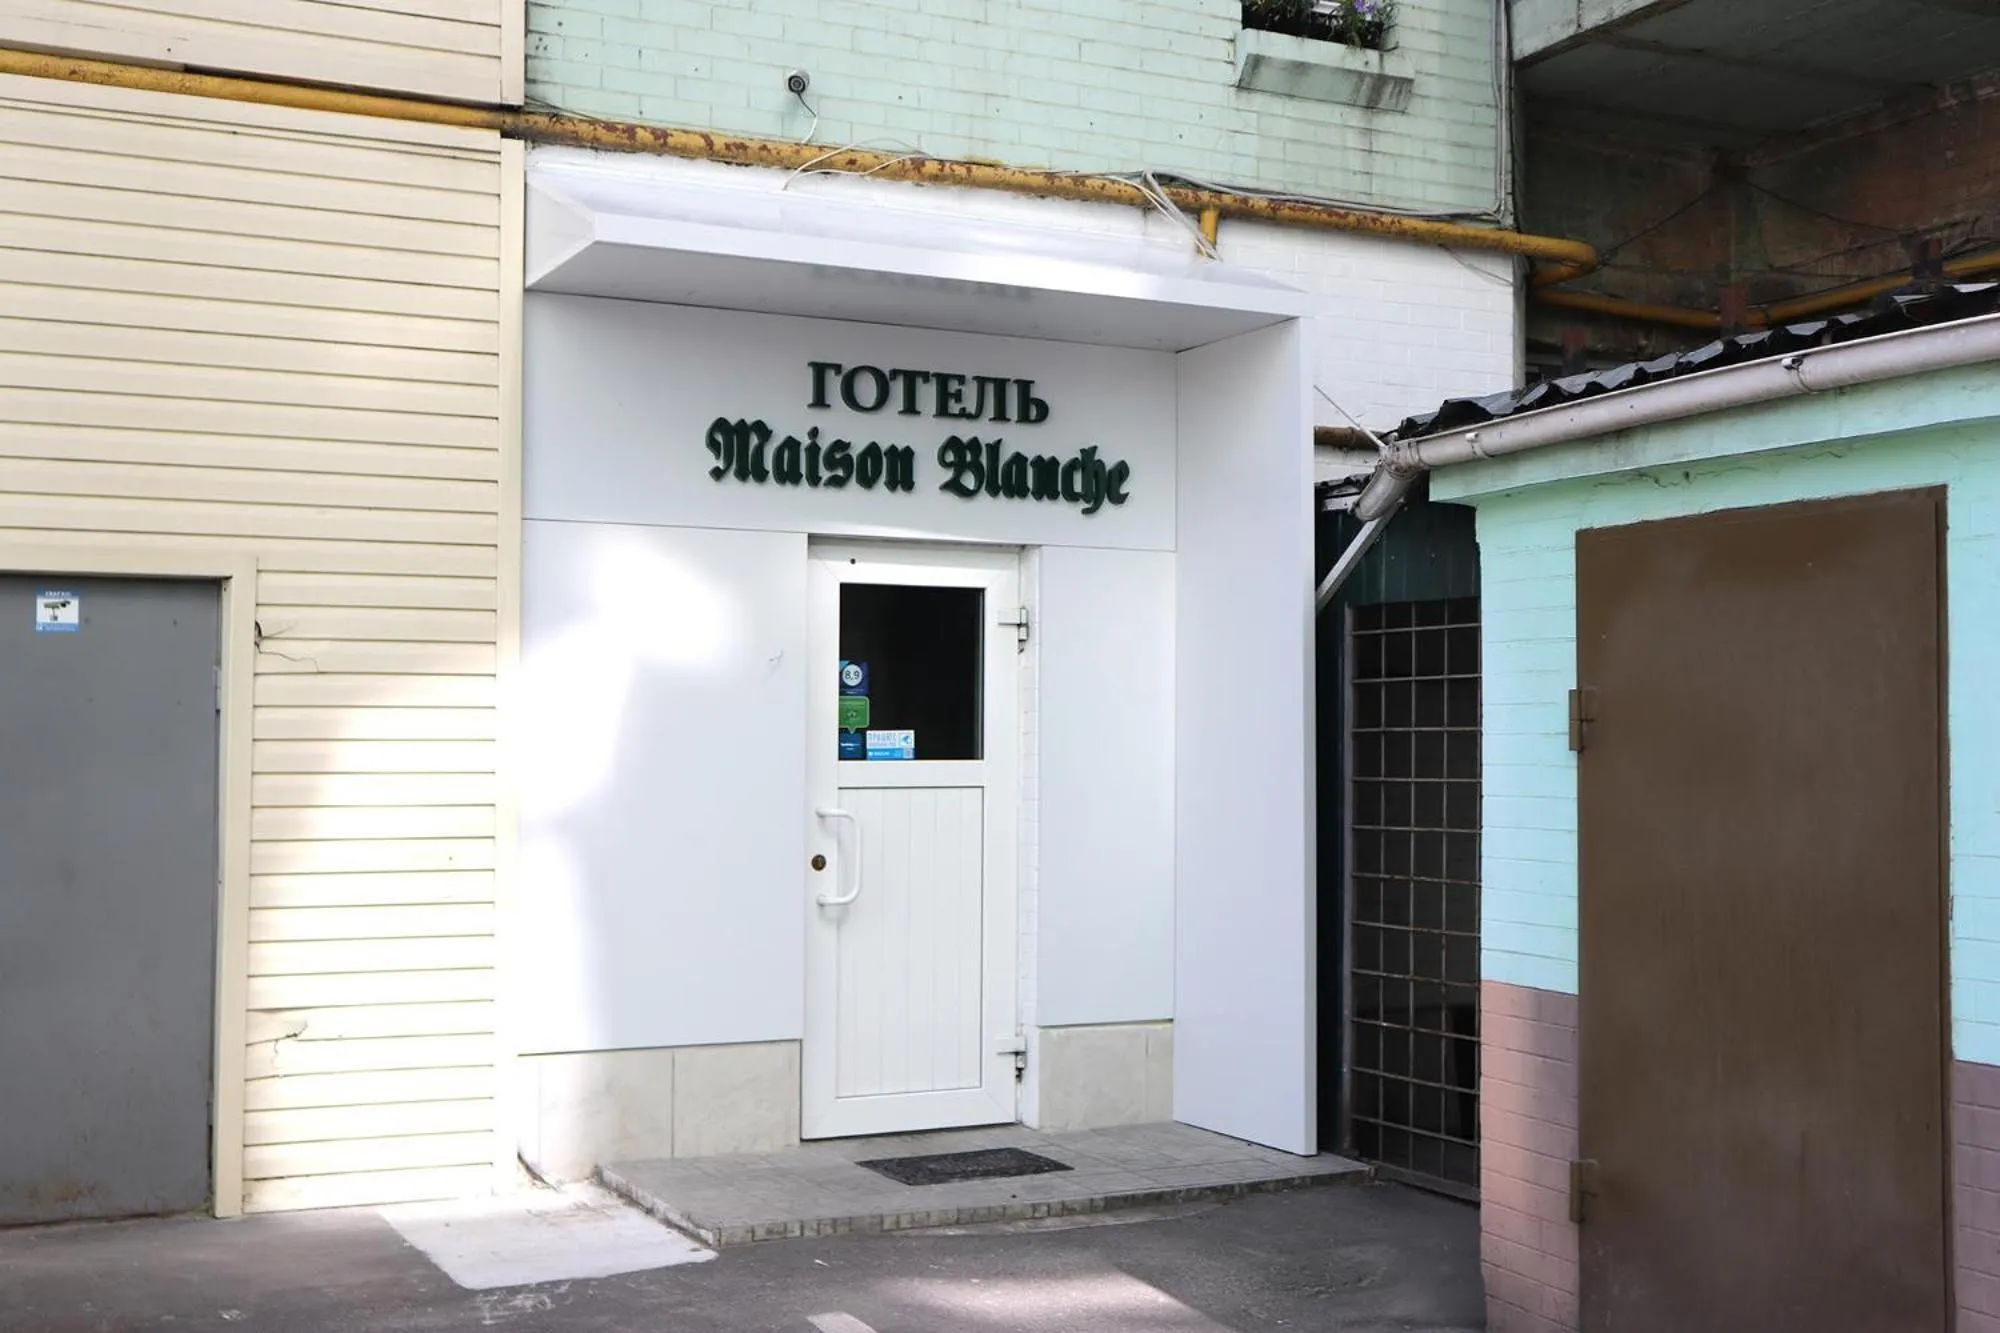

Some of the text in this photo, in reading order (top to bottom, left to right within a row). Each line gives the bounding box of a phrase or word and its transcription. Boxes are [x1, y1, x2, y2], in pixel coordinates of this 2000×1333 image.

[807, 361, 1050, 424] ГОТЕЛЬ
[706, 416, 1131, 516] Maison Blanche
